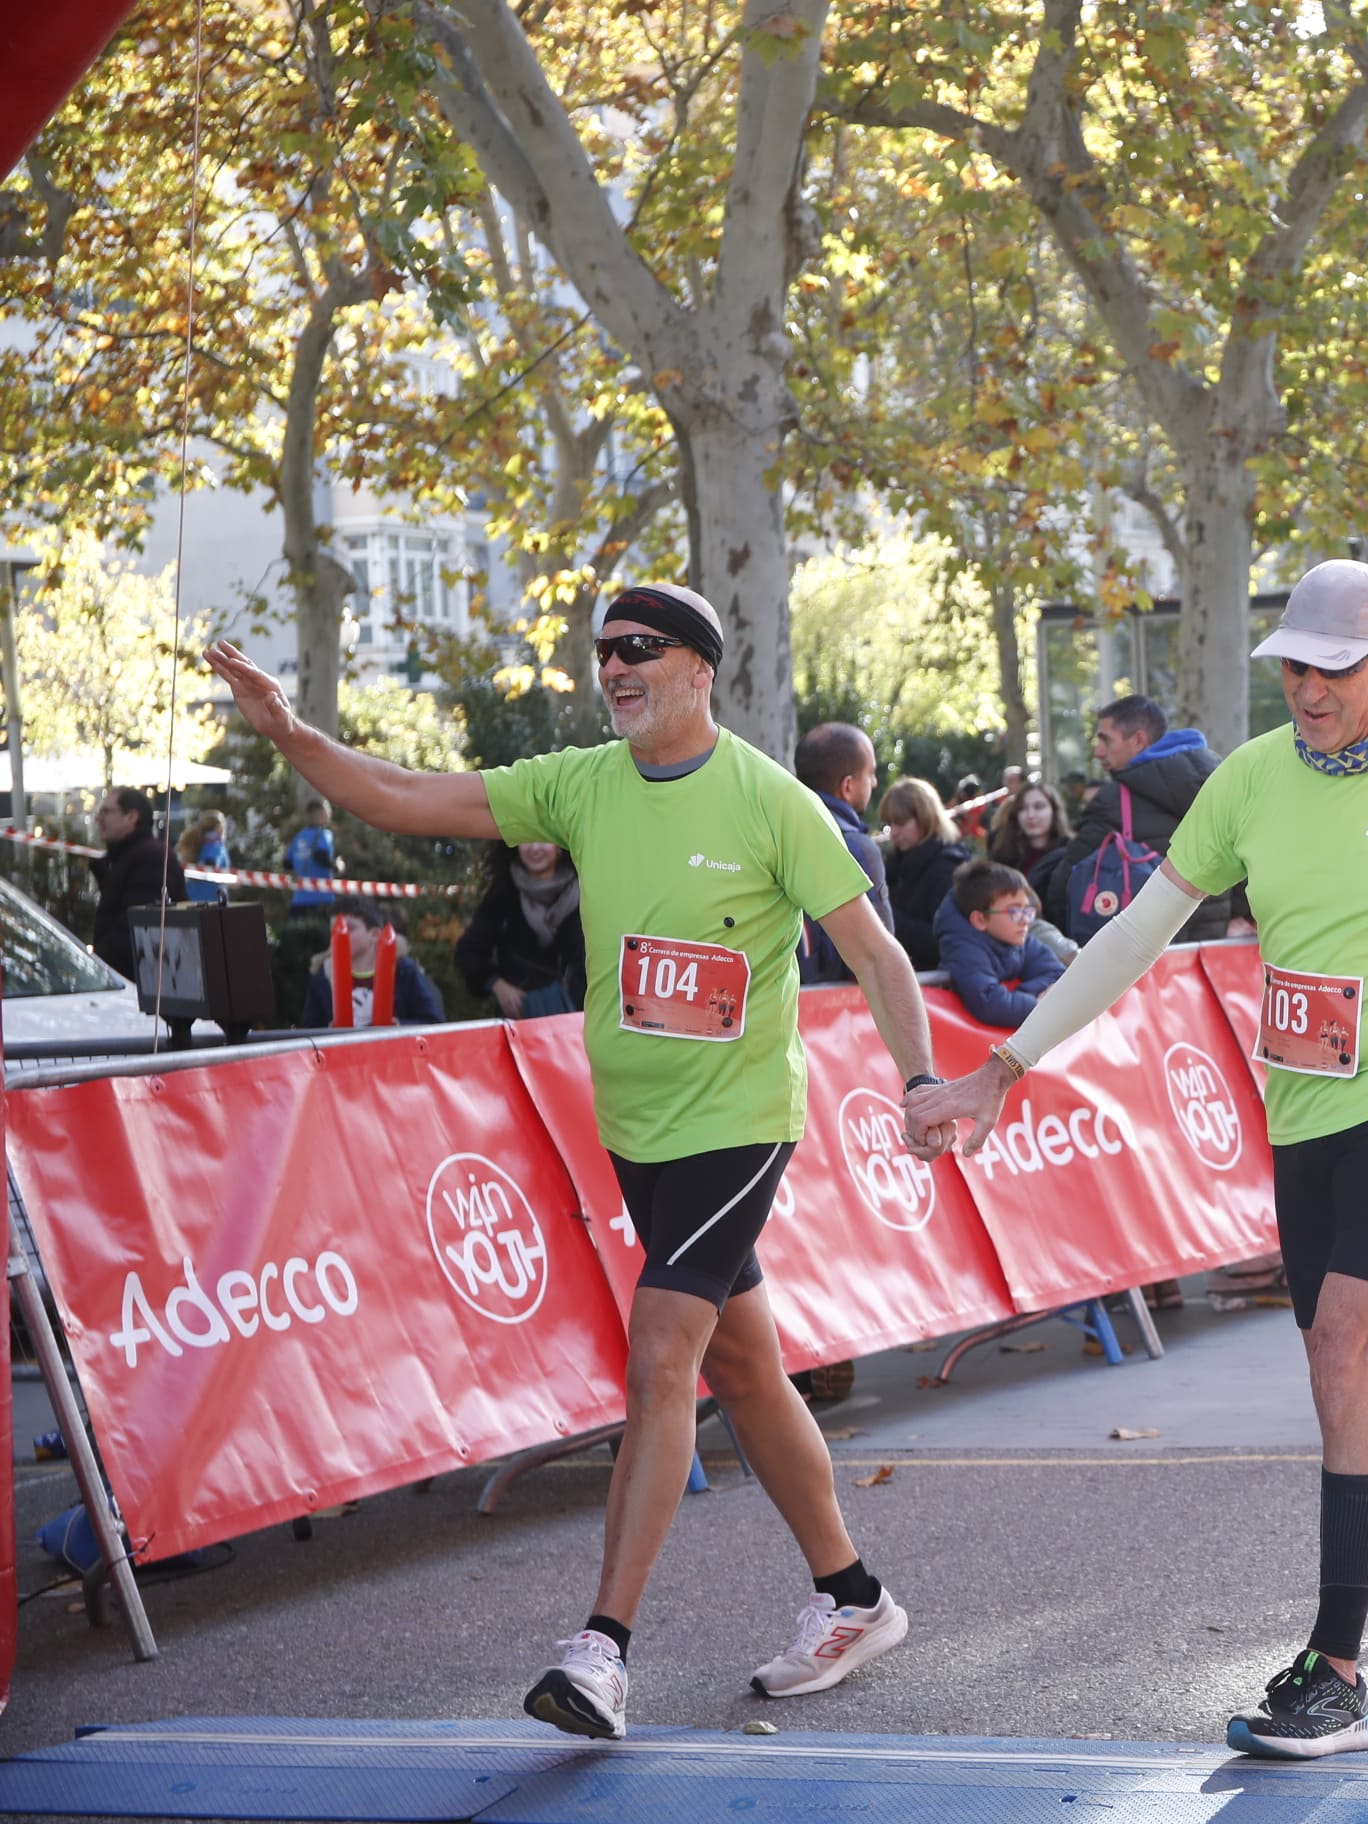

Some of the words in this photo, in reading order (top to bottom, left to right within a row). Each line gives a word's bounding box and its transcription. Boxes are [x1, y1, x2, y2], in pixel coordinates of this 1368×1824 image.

[706, 859, 742, 873] Unicaja
[649, 946, 670, 956] Carrera
[680, 950, 709, 961] empresas
[711, 954, 734, 963] Adecco
[638, 956, 699, 1001] 104
[1318, 985, 1342, 993] Adecco
[1267, 985, 1309, 1034] 103
[445, 1224, 546, 1299] YOUTH
[109, 1250, 359, 1369] Adecco
